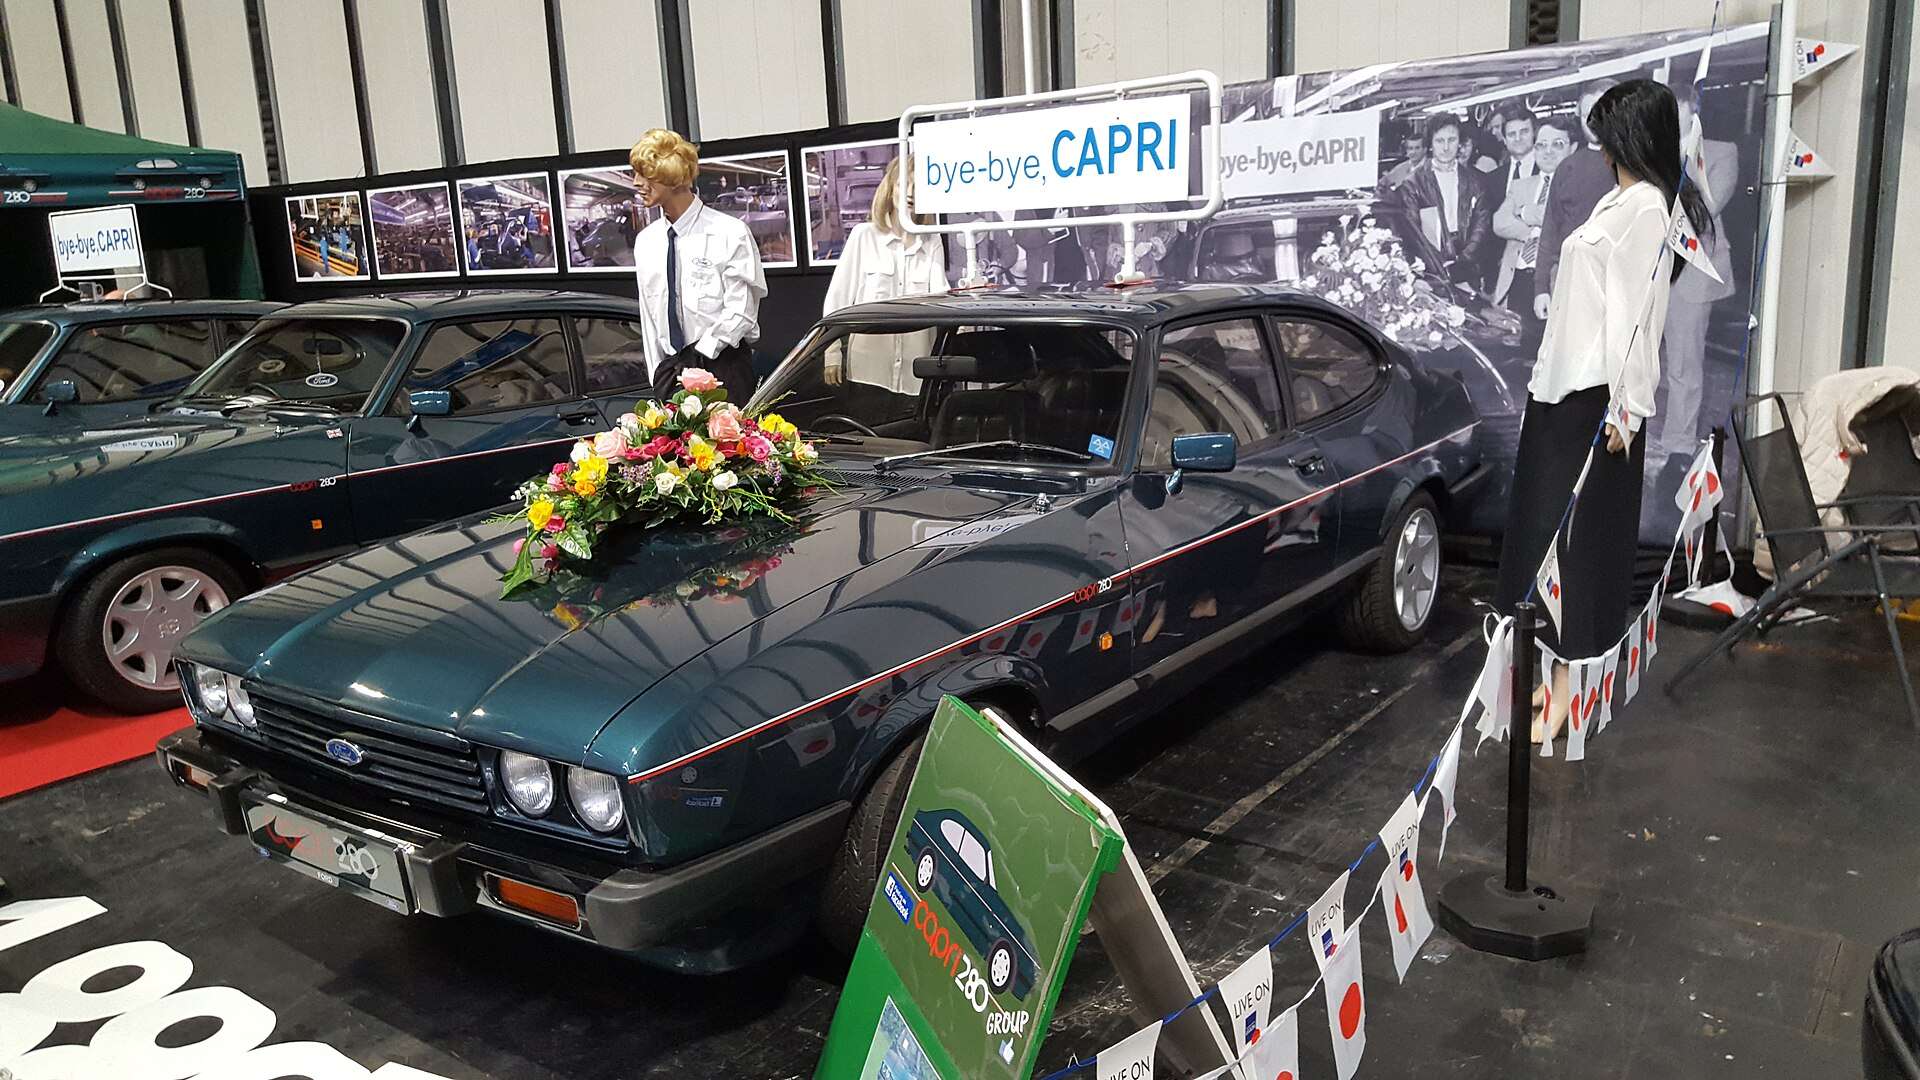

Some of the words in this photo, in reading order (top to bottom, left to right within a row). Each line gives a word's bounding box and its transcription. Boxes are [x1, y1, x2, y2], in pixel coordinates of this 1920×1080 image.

[927, 151, 1046, 194] bye-bye,
[1052, 119, 1177, 178] CAPRI
[1300, 136, 1366, 167] CAPRI
[58, 232, 100, 260] bye-bye,
[97, 227, 135, 252] CAPRI
[319, 476, 337, 488] 280
[1391, 834, 1406, 859] LIVE
[1406, 820, 1418, 840] ON
[1312, 912, 1327, 938] LIVE
[1328, 898, 1342, 920] ON
[1233, 991, 1253, 1019] LIVE
[1254, 978, 1271, 1002] ON
[986, 1010, 1030, 1034] GROUP
[1130, 1055, 1151, 1080] ON
